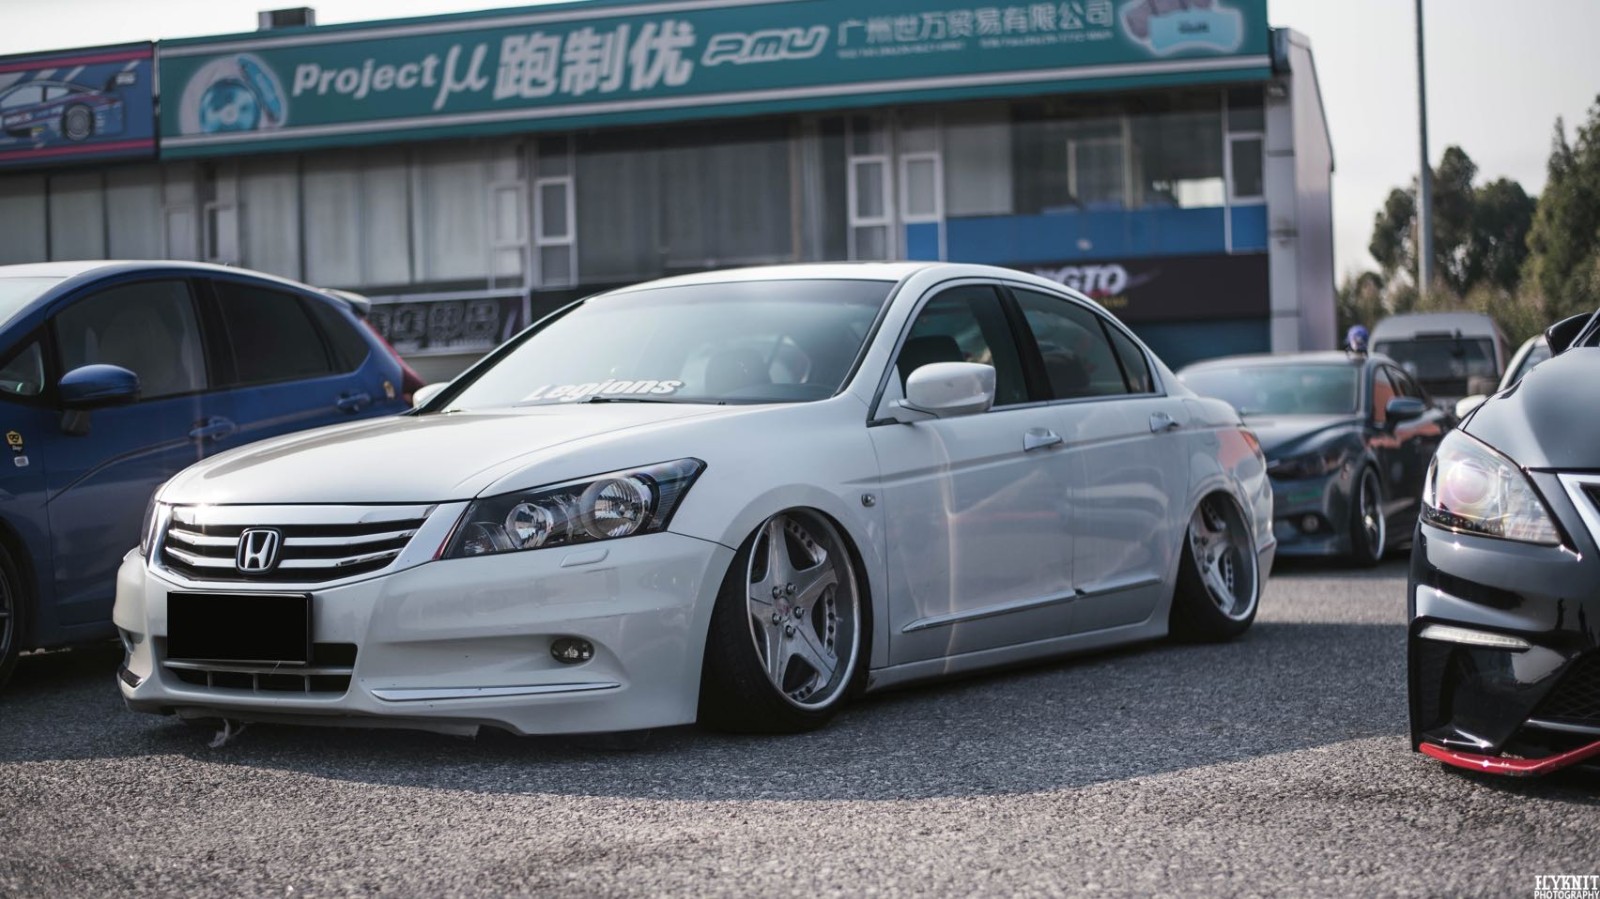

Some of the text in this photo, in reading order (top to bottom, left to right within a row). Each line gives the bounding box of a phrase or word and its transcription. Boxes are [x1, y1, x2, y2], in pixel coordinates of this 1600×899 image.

[293, 55, 439, 98] Project
[494, 20, 696, 100] 跑制优
[520, 378, 683, 402] Legions
